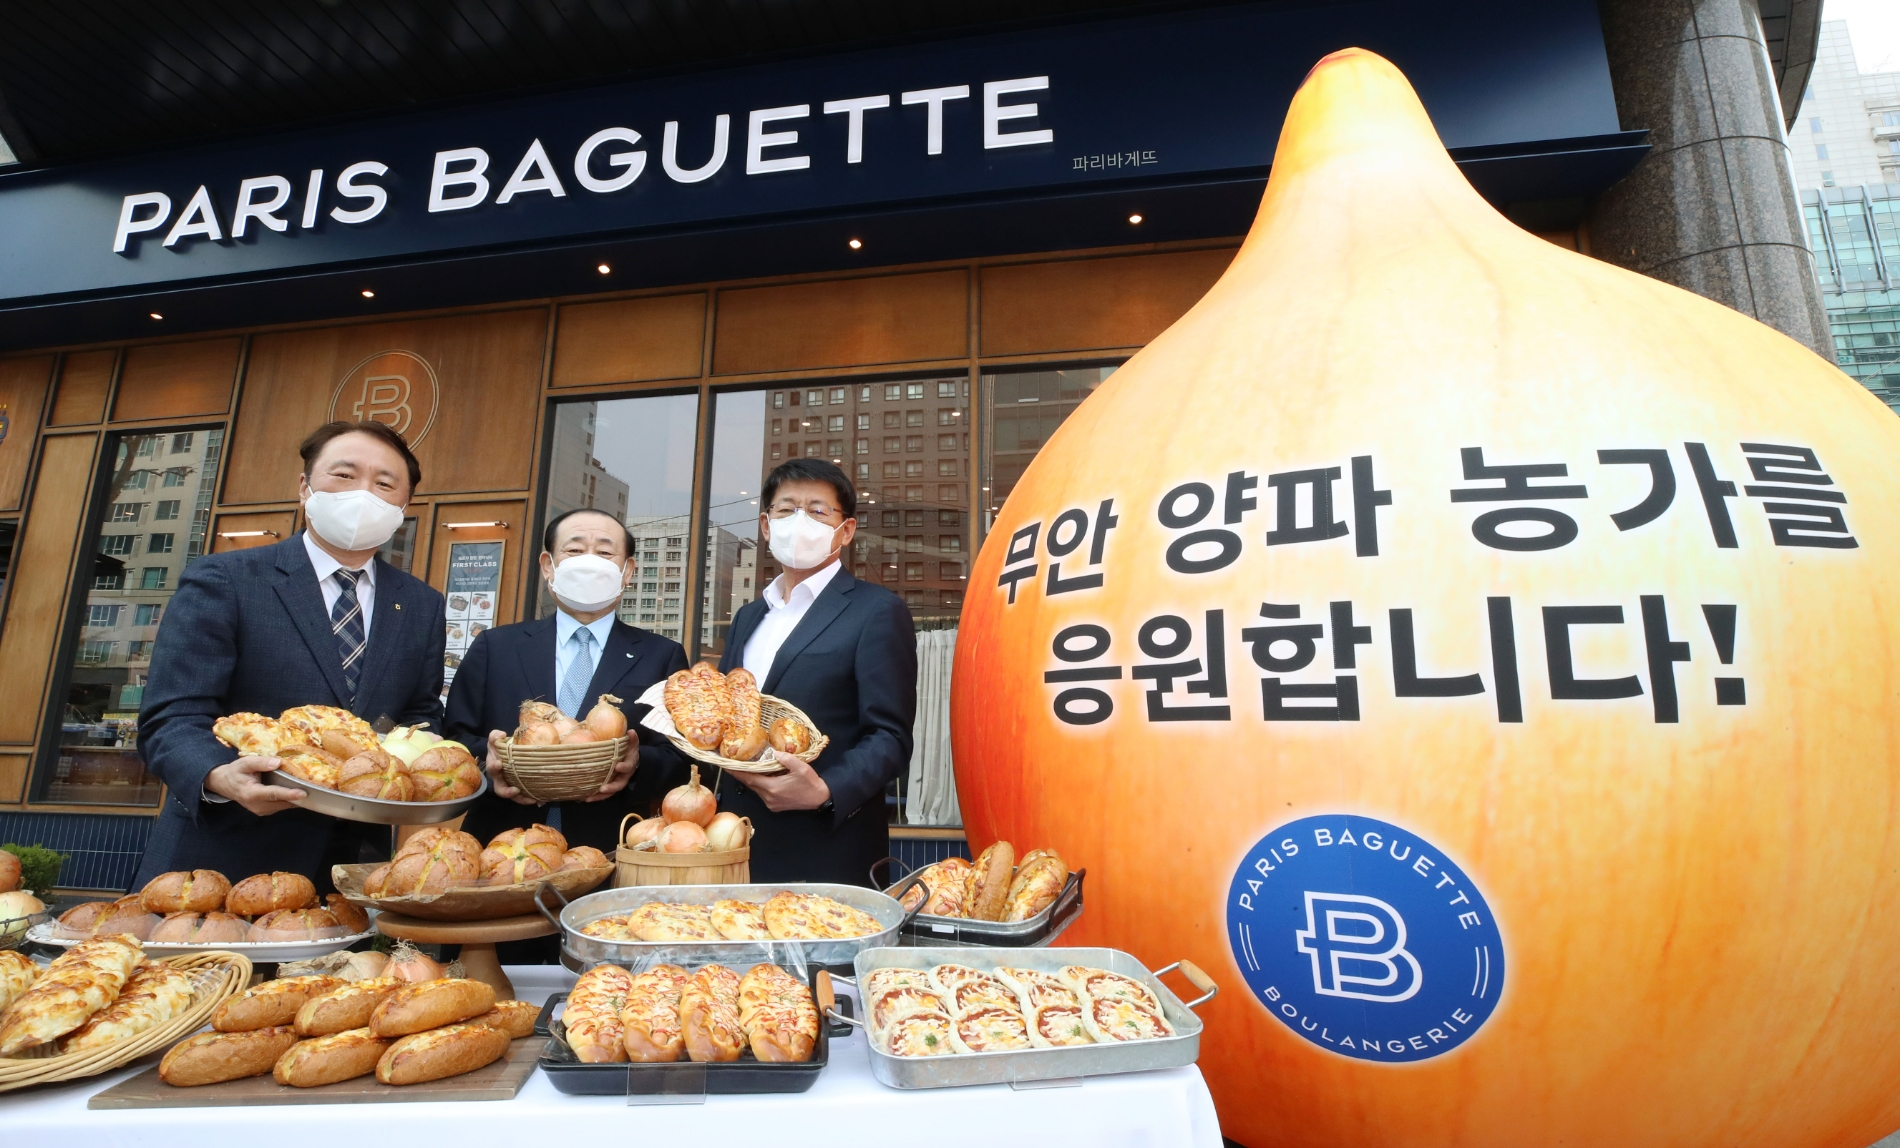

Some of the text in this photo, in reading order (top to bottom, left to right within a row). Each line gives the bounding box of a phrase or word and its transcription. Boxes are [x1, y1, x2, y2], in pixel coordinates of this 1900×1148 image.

[113, 75, 1054, 253] PARIS BAGUETTE
[1072, 150, 1159, 172] 파리바게뜨
[997, 441, 1860, 605] 무안 양파 농가를
[1044, 594, 1747, 726] 응원합니다!
[1238, 828, 1481, 930] PARIS BAGUETTE
[1263, 985, 1474, 1054] BOULANGERIE
